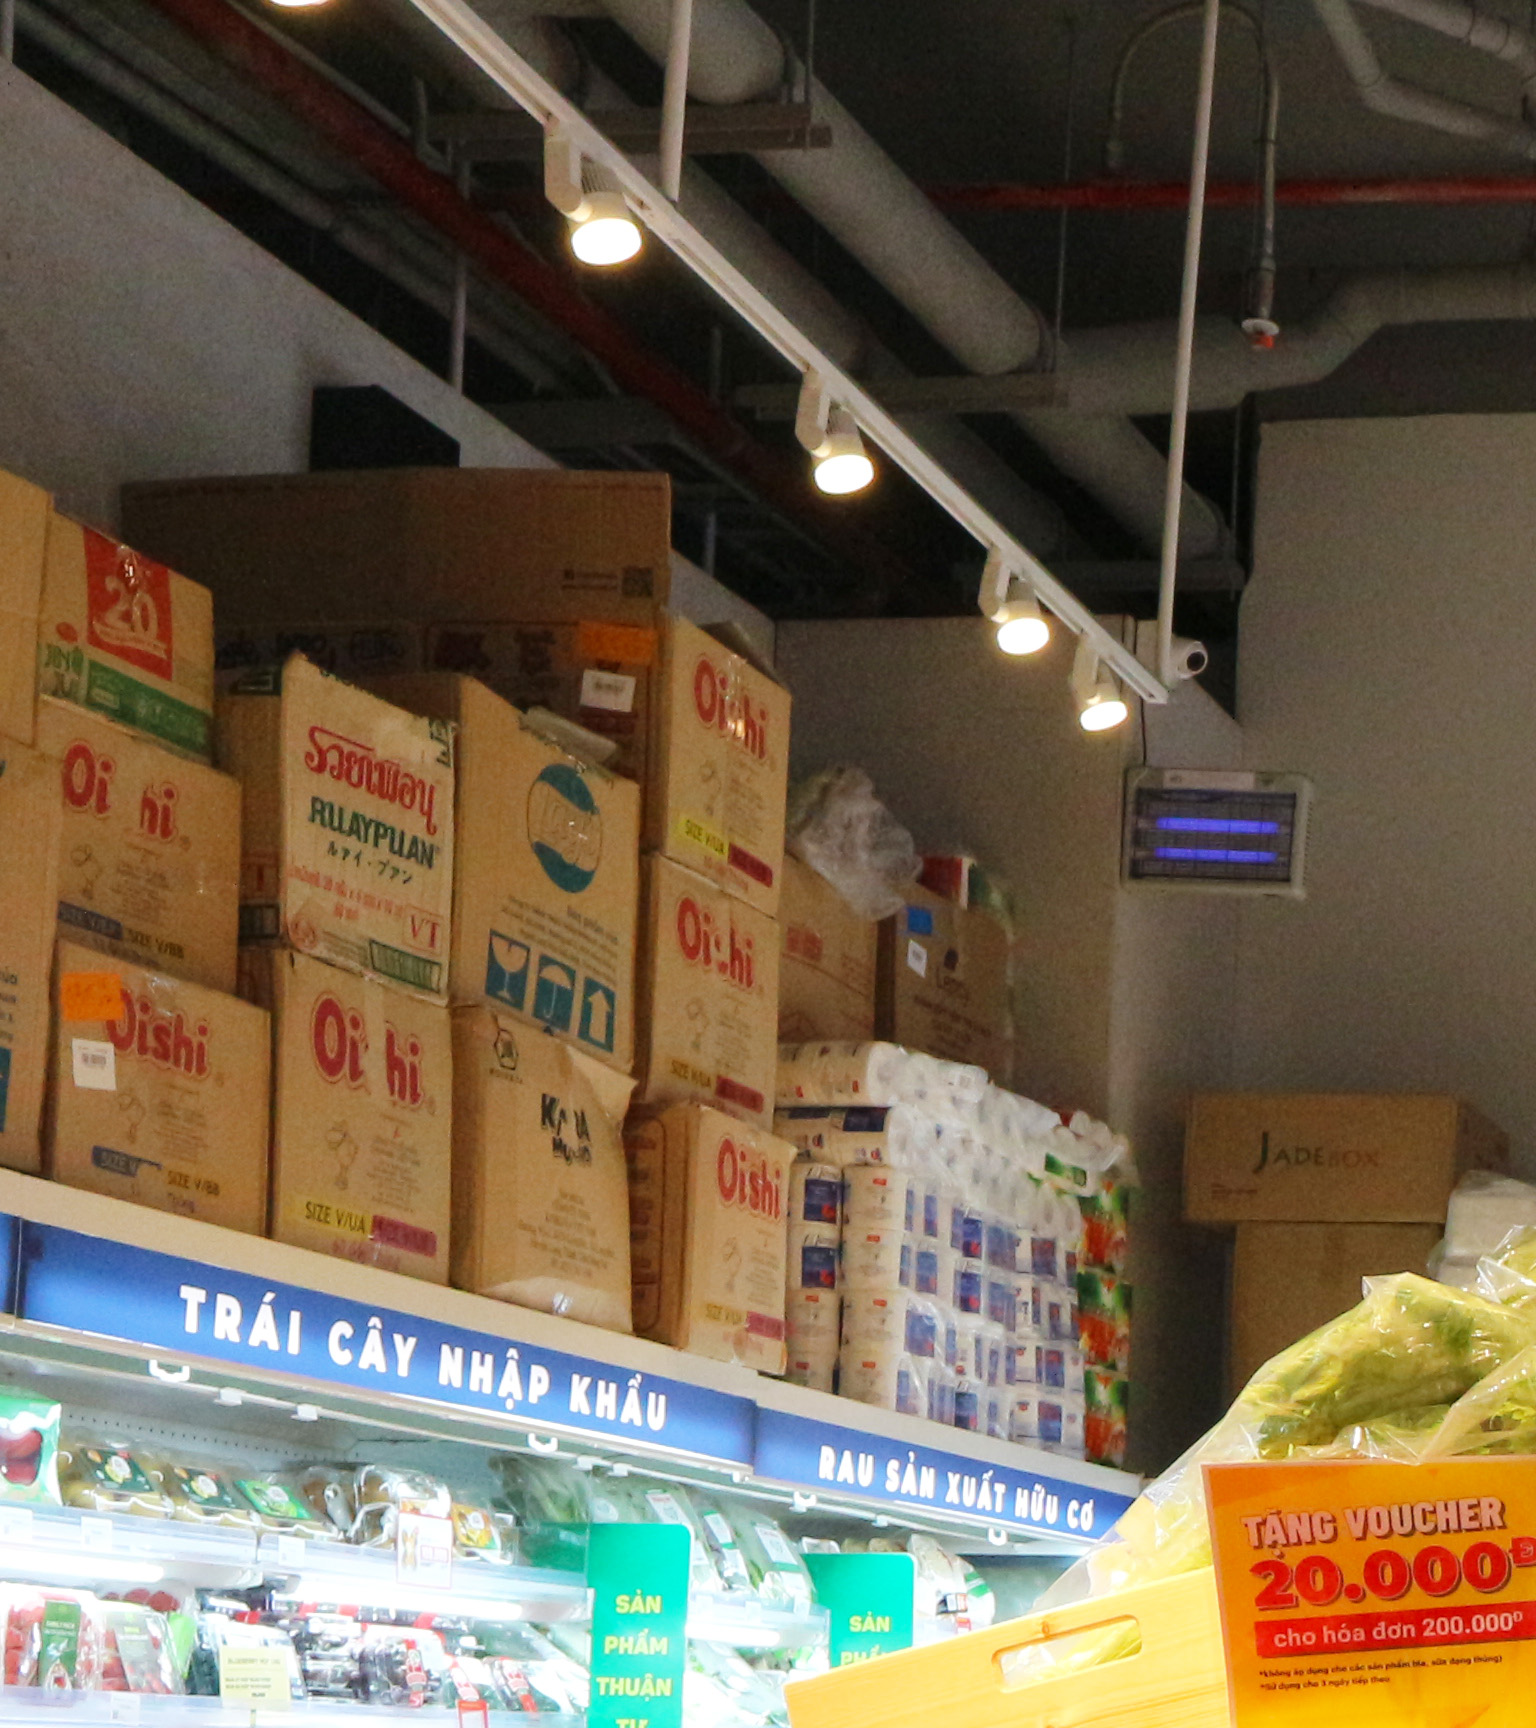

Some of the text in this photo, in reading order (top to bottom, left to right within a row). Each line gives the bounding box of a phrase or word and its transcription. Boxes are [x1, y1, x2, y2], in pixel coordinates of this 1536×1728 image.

[693, 658, 769, 761] Oihi
[61, 743, 175, 840] Oihi
[410, 914, 440, 949] VT
[313, 998, 422, 1106] Oihi
[716, 1137, 782, 1220] Oishi
[305, 1200, 367, 1235] SIZE V/UA
[179, 1284, 667, 1432] TRÁI CÂY NHẬP KHẨU
[818, 1445, 1095, 1531] RAU SẢN XUẤT HỮU CƠ
[1242, 1497, 1507, 1561] TẶNG VOUCHER
[615, 1588, 663, 1615] SẢN
[848, 1611, 891, 1634] SẢN
[604, 1628, 669, 1656] PHẨM
[1273, 1627, 1316, 1648] cho
[1322, 1622, 1367, 1645] hóa
[1372, 1618, 1417, 1641] đơn
[596, 1674, 673, 1703] THUẬN
